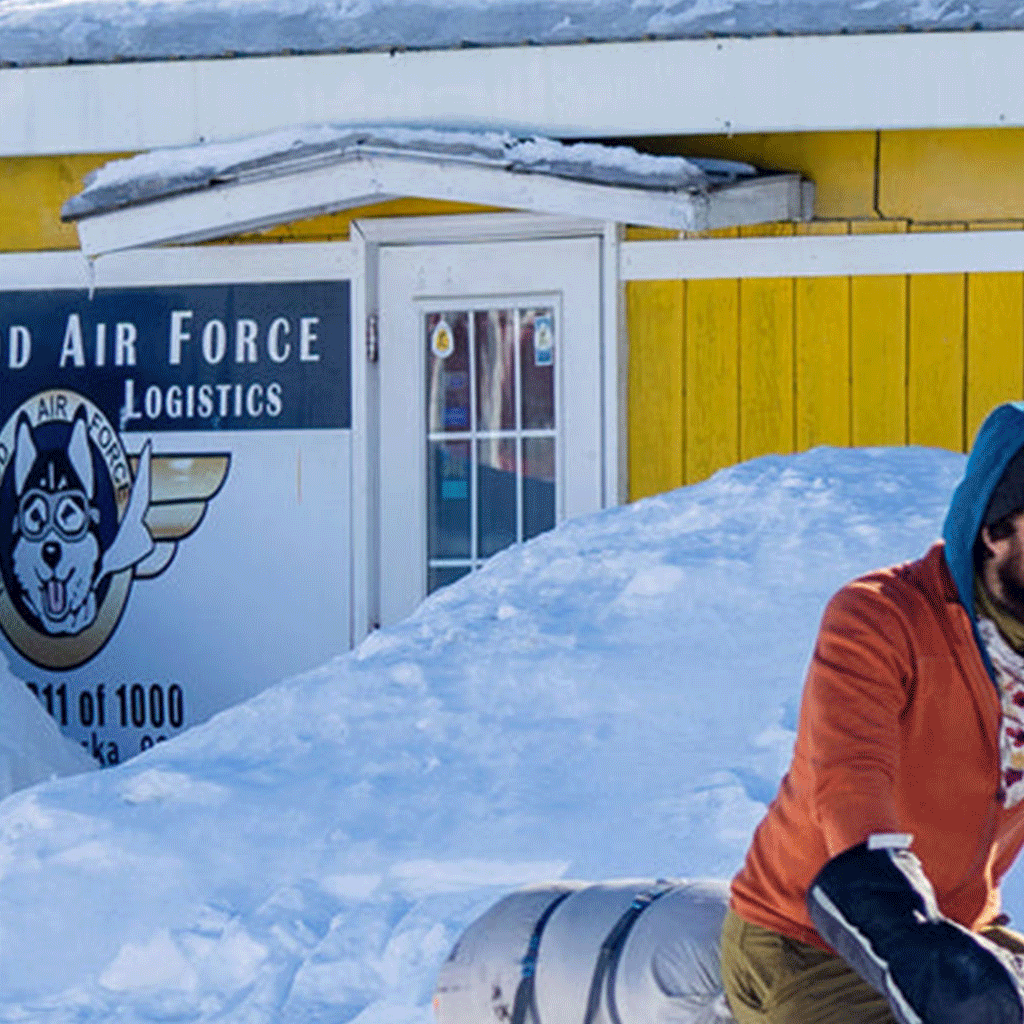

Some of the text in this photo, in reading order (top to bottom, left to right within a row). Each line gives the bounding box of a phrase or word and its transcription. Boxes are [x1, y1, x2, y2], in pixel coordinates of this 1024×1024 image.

[60, 313, 137, 368] AIR
[169, 310, 321, 365] FORCE
[36, 394, 69, 421] AIR
[26, 681, 184, 728] 11 of 1000
